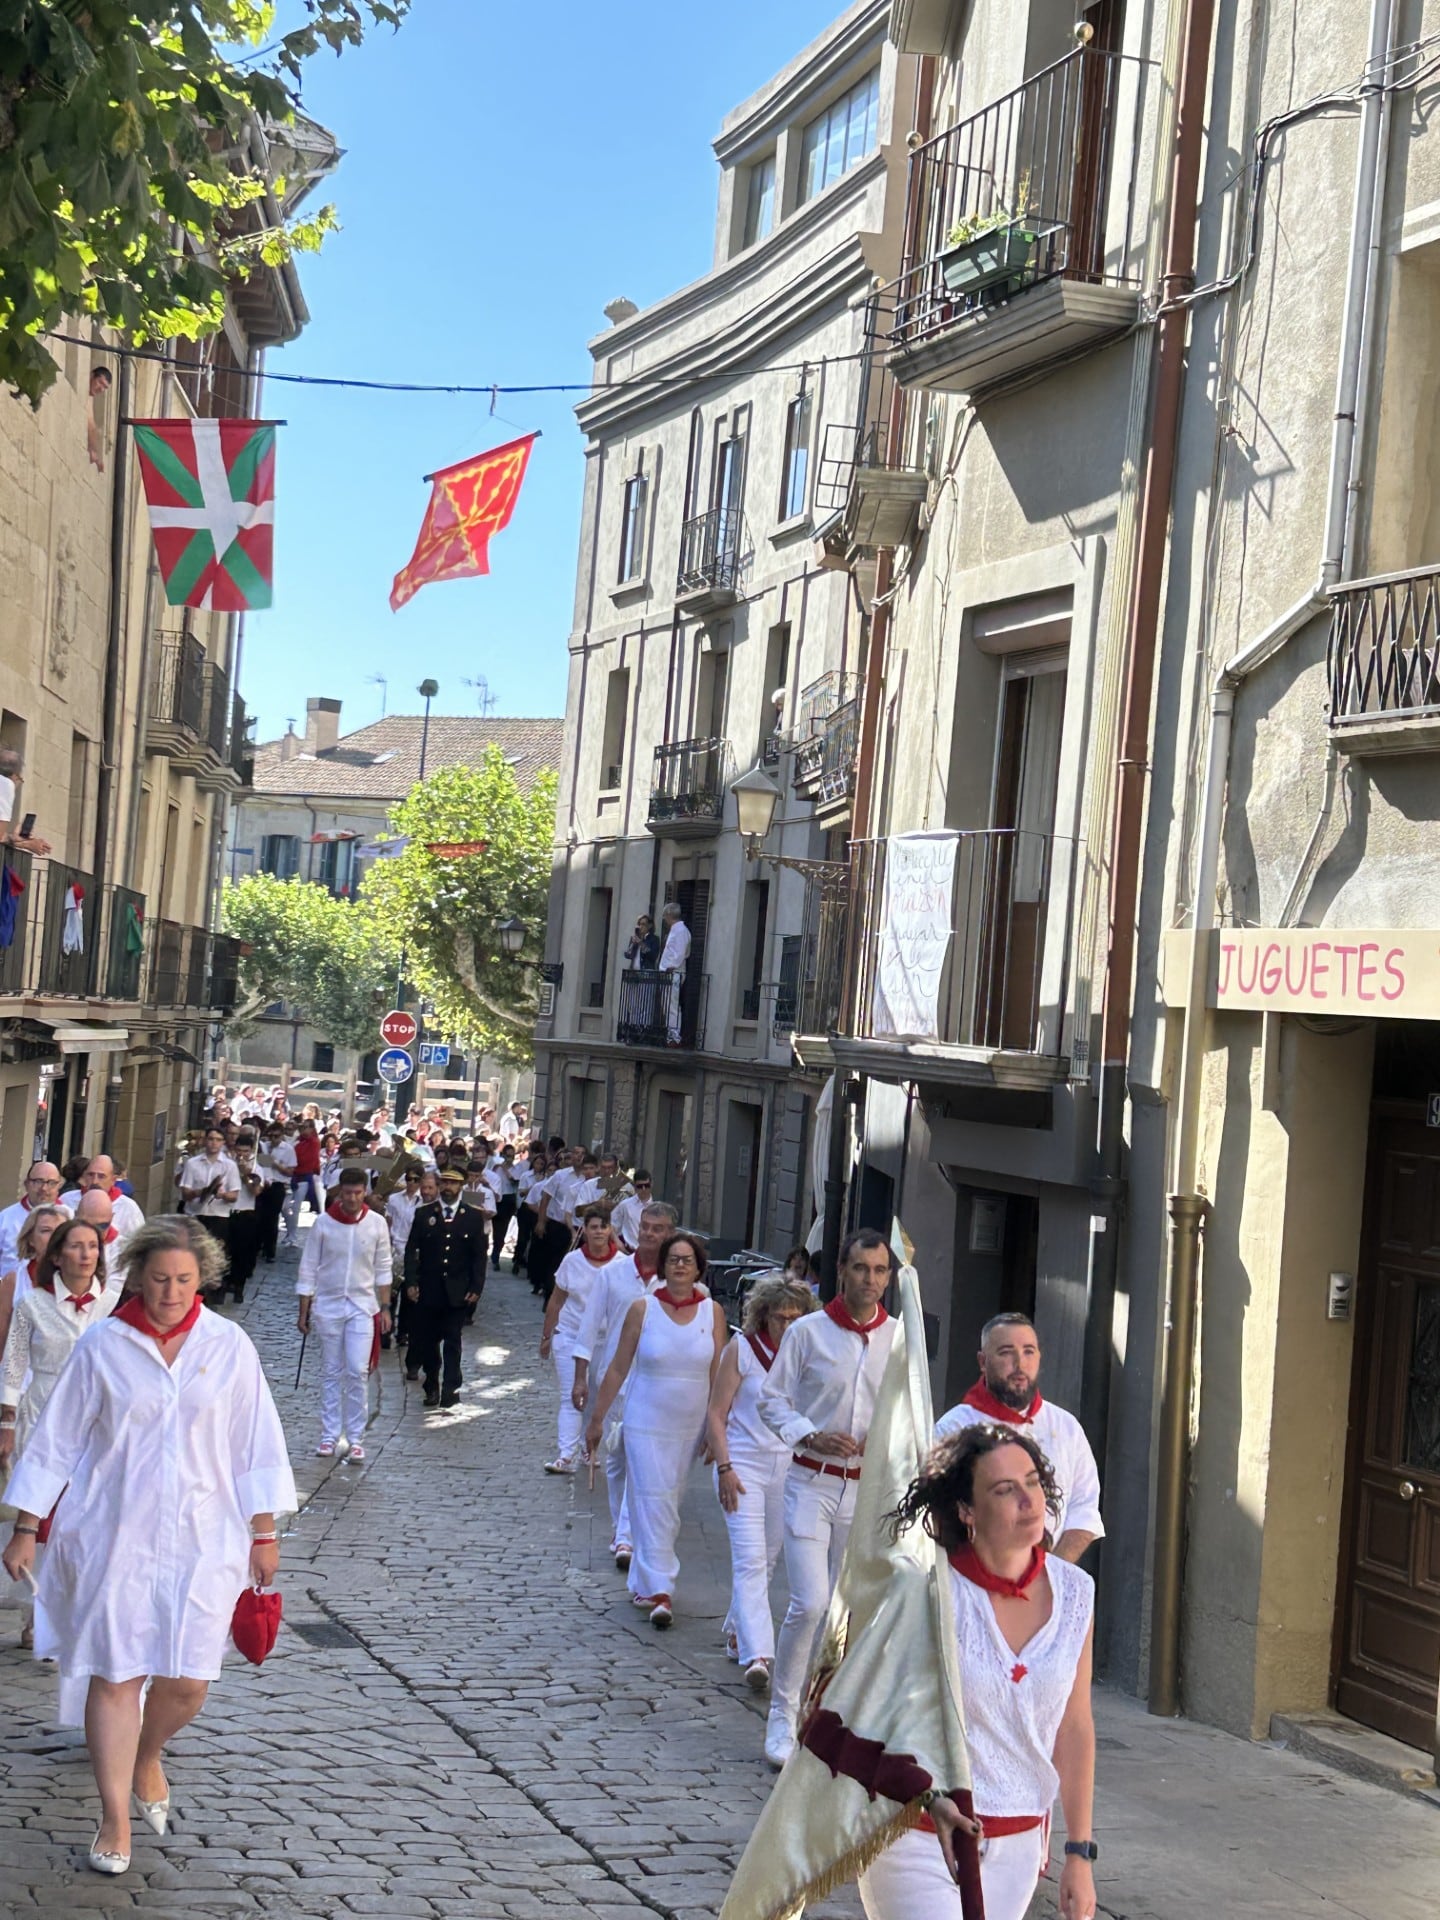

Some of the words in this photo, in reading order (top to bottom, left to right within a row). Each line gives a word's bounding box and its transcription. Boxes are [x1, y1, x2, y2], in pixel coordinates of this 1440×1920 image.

[1218, 942, 1405, 1001] JUGUETES
[384, 1024, 415, 1034] STOP
[422, 1046, 430, 1061] P
